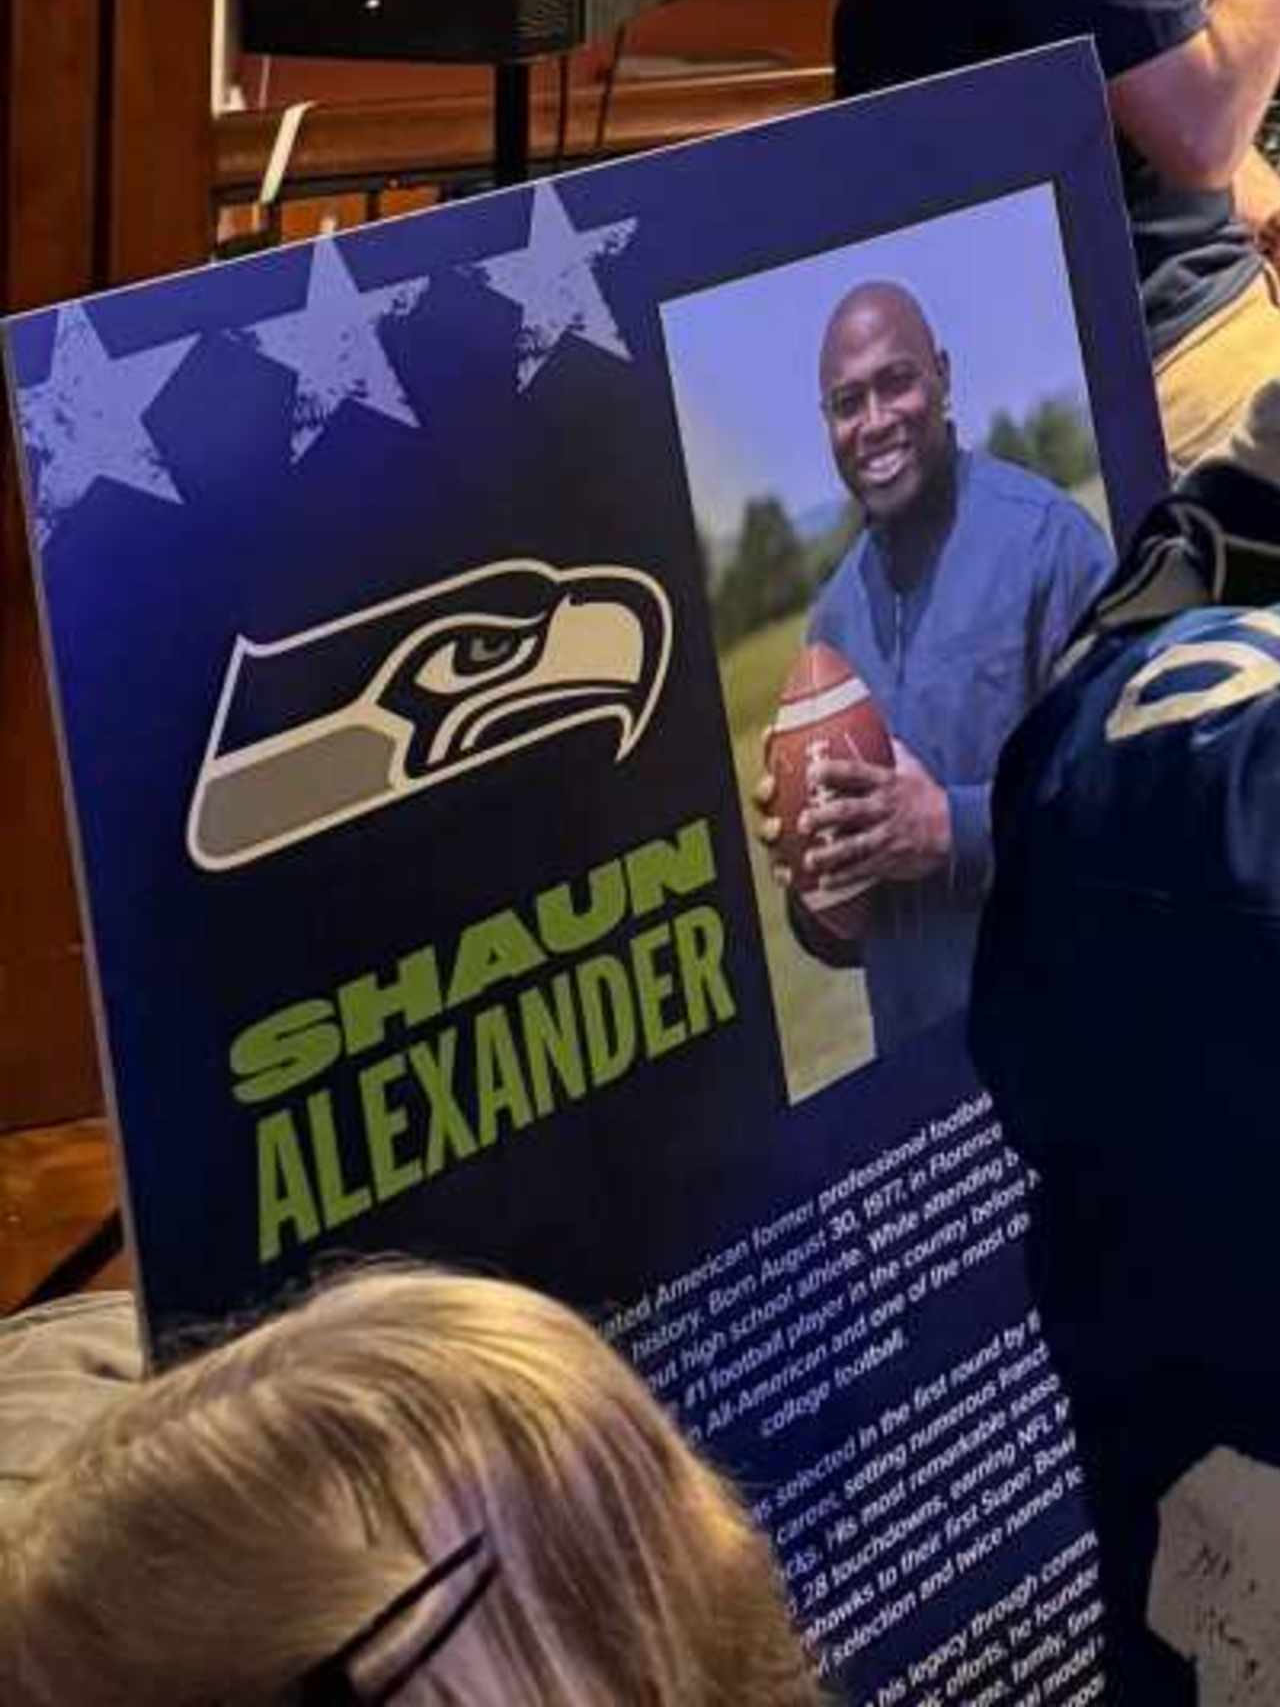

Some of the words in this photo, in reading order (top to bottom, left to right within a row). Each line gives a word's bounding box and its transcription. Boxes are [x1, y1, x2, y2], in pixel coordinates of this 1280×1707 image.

[229, 818, 718, 1104] SHAUN
[256, 904, 737, 1265] ALEXANDER
[658, 1241, 748, 1310] American
[753, 1201, 813, 1250] former
[819, 1128, 925, 1213] professional
[681, 1332, 725, 1371] high
[730, 1285, 792, 1341] school
[867, 1212, 916, 1253] While
[924, 1159, 1002, 1220] attending
[686, 1378, 706, 1407] #1
[710, 1329, 782, 1393] football
[788, 1294, 844, 1349] player
[849, 1281, 866, 1304] in
[870, 1261, 899, 1290] the
[905, 1216, 967, 1268] country
[972, 1180, 1024, 1224] before
[709, 1275, 754, 1315] Born
[761, 1229, 826, 1285] August
[910, 1170, 926, 1191] in
[707, 1344, 826, 1436] All-American
[832, 1314, 865, 1352] and
[870, 1294, 904, 1327] one
[908, 1273, 926, 1301] of
[930, 1259, 958, 1288] the
[963, 1227, 1004, 1266] most
[763, 1381, 829, 1436] college
[834, 1329, 908, 1392] football.
[777, 1436, 856, 1507] selected
[860, 1425, 877, 1449] in
[880, 1403, 910, 1435] the
[914, 1374, 946, 1410] first
[951, 1335, 1001, 1385] round
[1004, 1323, 1024, 1349] by
[803, 1573, 828, 1608] 28
[832, 1495, 947, 1586] touchdowns,
[950, 1443, 1015, 1499] earning
[1018, 1415, 1052, 1449] NFL
[827, 1517, 858, 1549] His
[862, 1479, 906, 1525] most
[910, 1411, 1006, 1491] remarkable
[845, 1444, 906, 1499] setting
[911, 1381, 995, 1452] numerous
[878, 1567, 897, 1591] to
[901, 1533, 940, 1574] their
[945, 1504, 978, 1541] first
[982, 1466, 1031, 1515] Super
[833, 1592, 916, 1666] selection
[921, 1558, 954, 1600] and
[956, 1528, 1002, 1572] twice
[1007, 1476, 1062, 1535] named
[971, 1575, 1037, 1637] through
[1010, 1619, 1031, 1646] he
